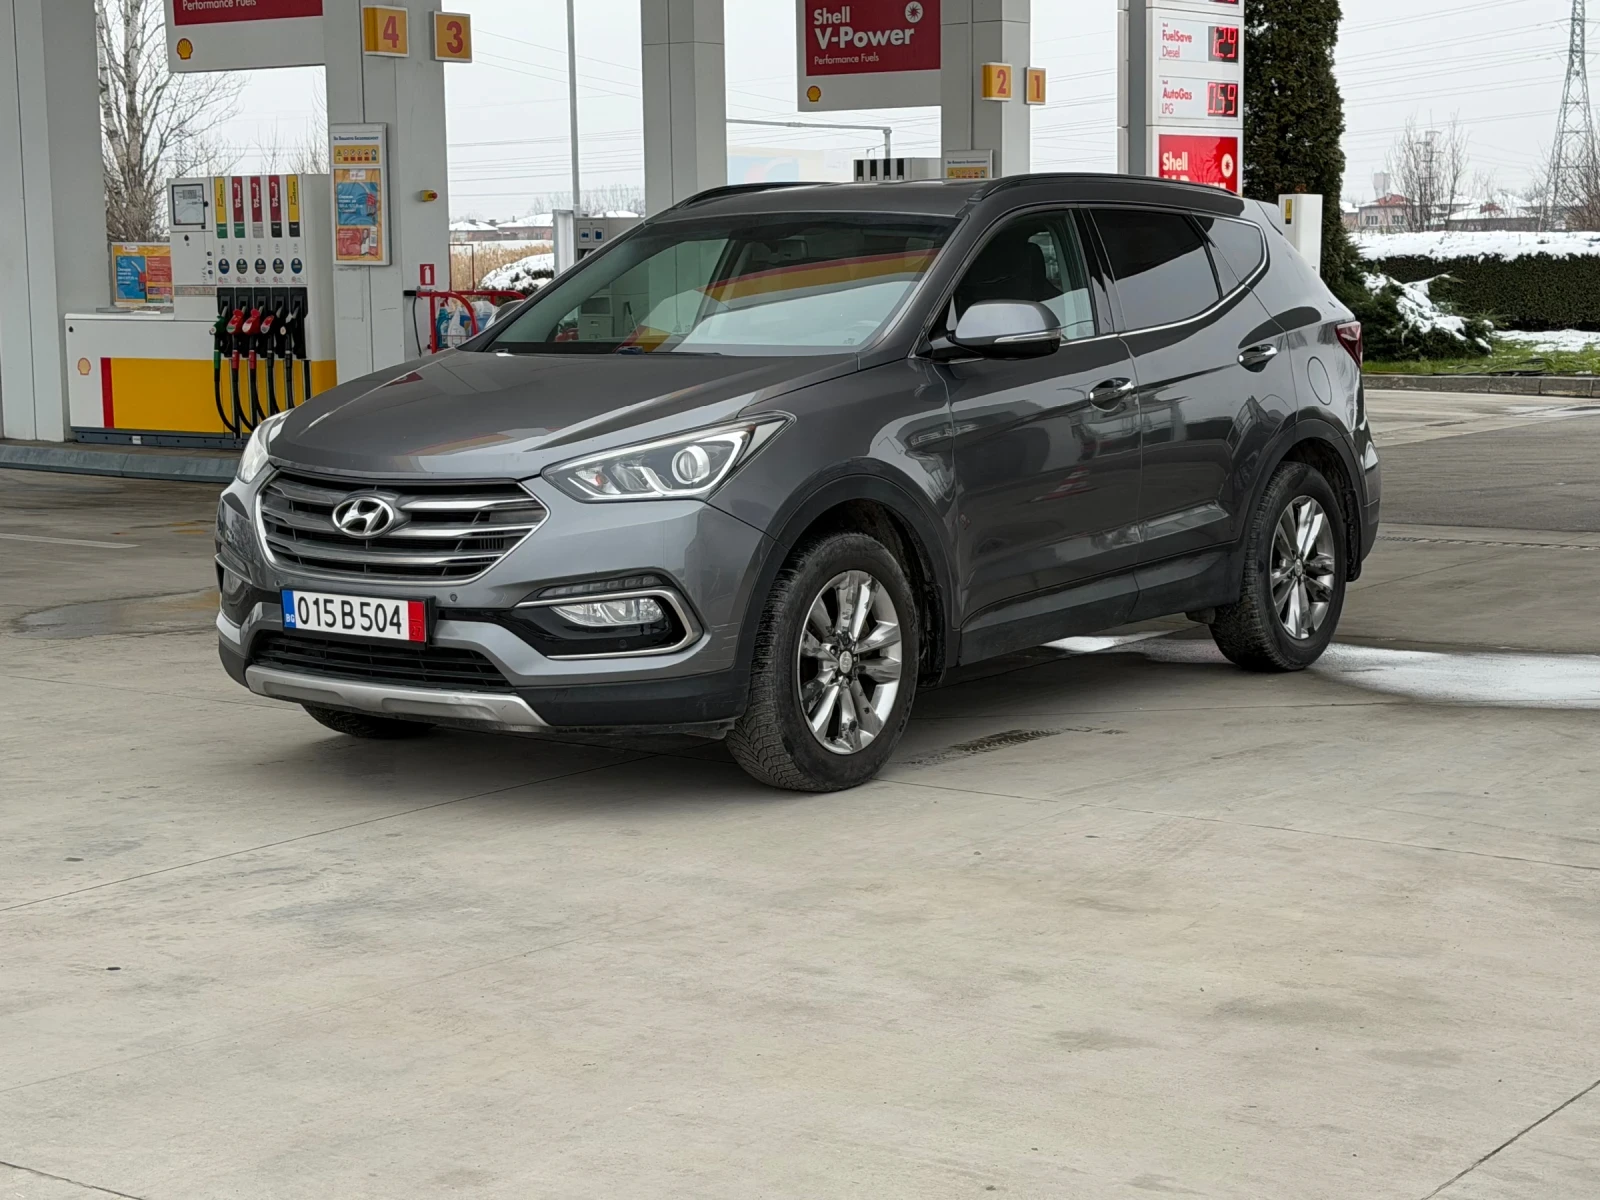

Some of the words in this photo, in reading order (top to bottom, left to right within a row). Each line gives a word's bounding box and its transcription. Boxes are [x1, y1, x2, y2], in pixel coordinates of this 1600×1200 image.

[813, 6, 851, 25] Shell
[383, 15, 399, 48] 4
[446, 21, 463, 54] 3
[814, 26, 915, 50] V-Power
[1162, 29, 1193, 43] FuelSave
[814, 54, 860, 65] Performance
[860, 52, 880, 63] Fuels
[1162, 45, 1181, 58] Diesel
[996, 69, 1007, 95] 2
[1034, 75, 1041, 99] 1
[1162, 87, 1193, 101] AutoGas
[1161, 103, 1175, 115] LPG
[1162, 151, 1189, 171] Shell
[285, 613, 296, 623] BG
